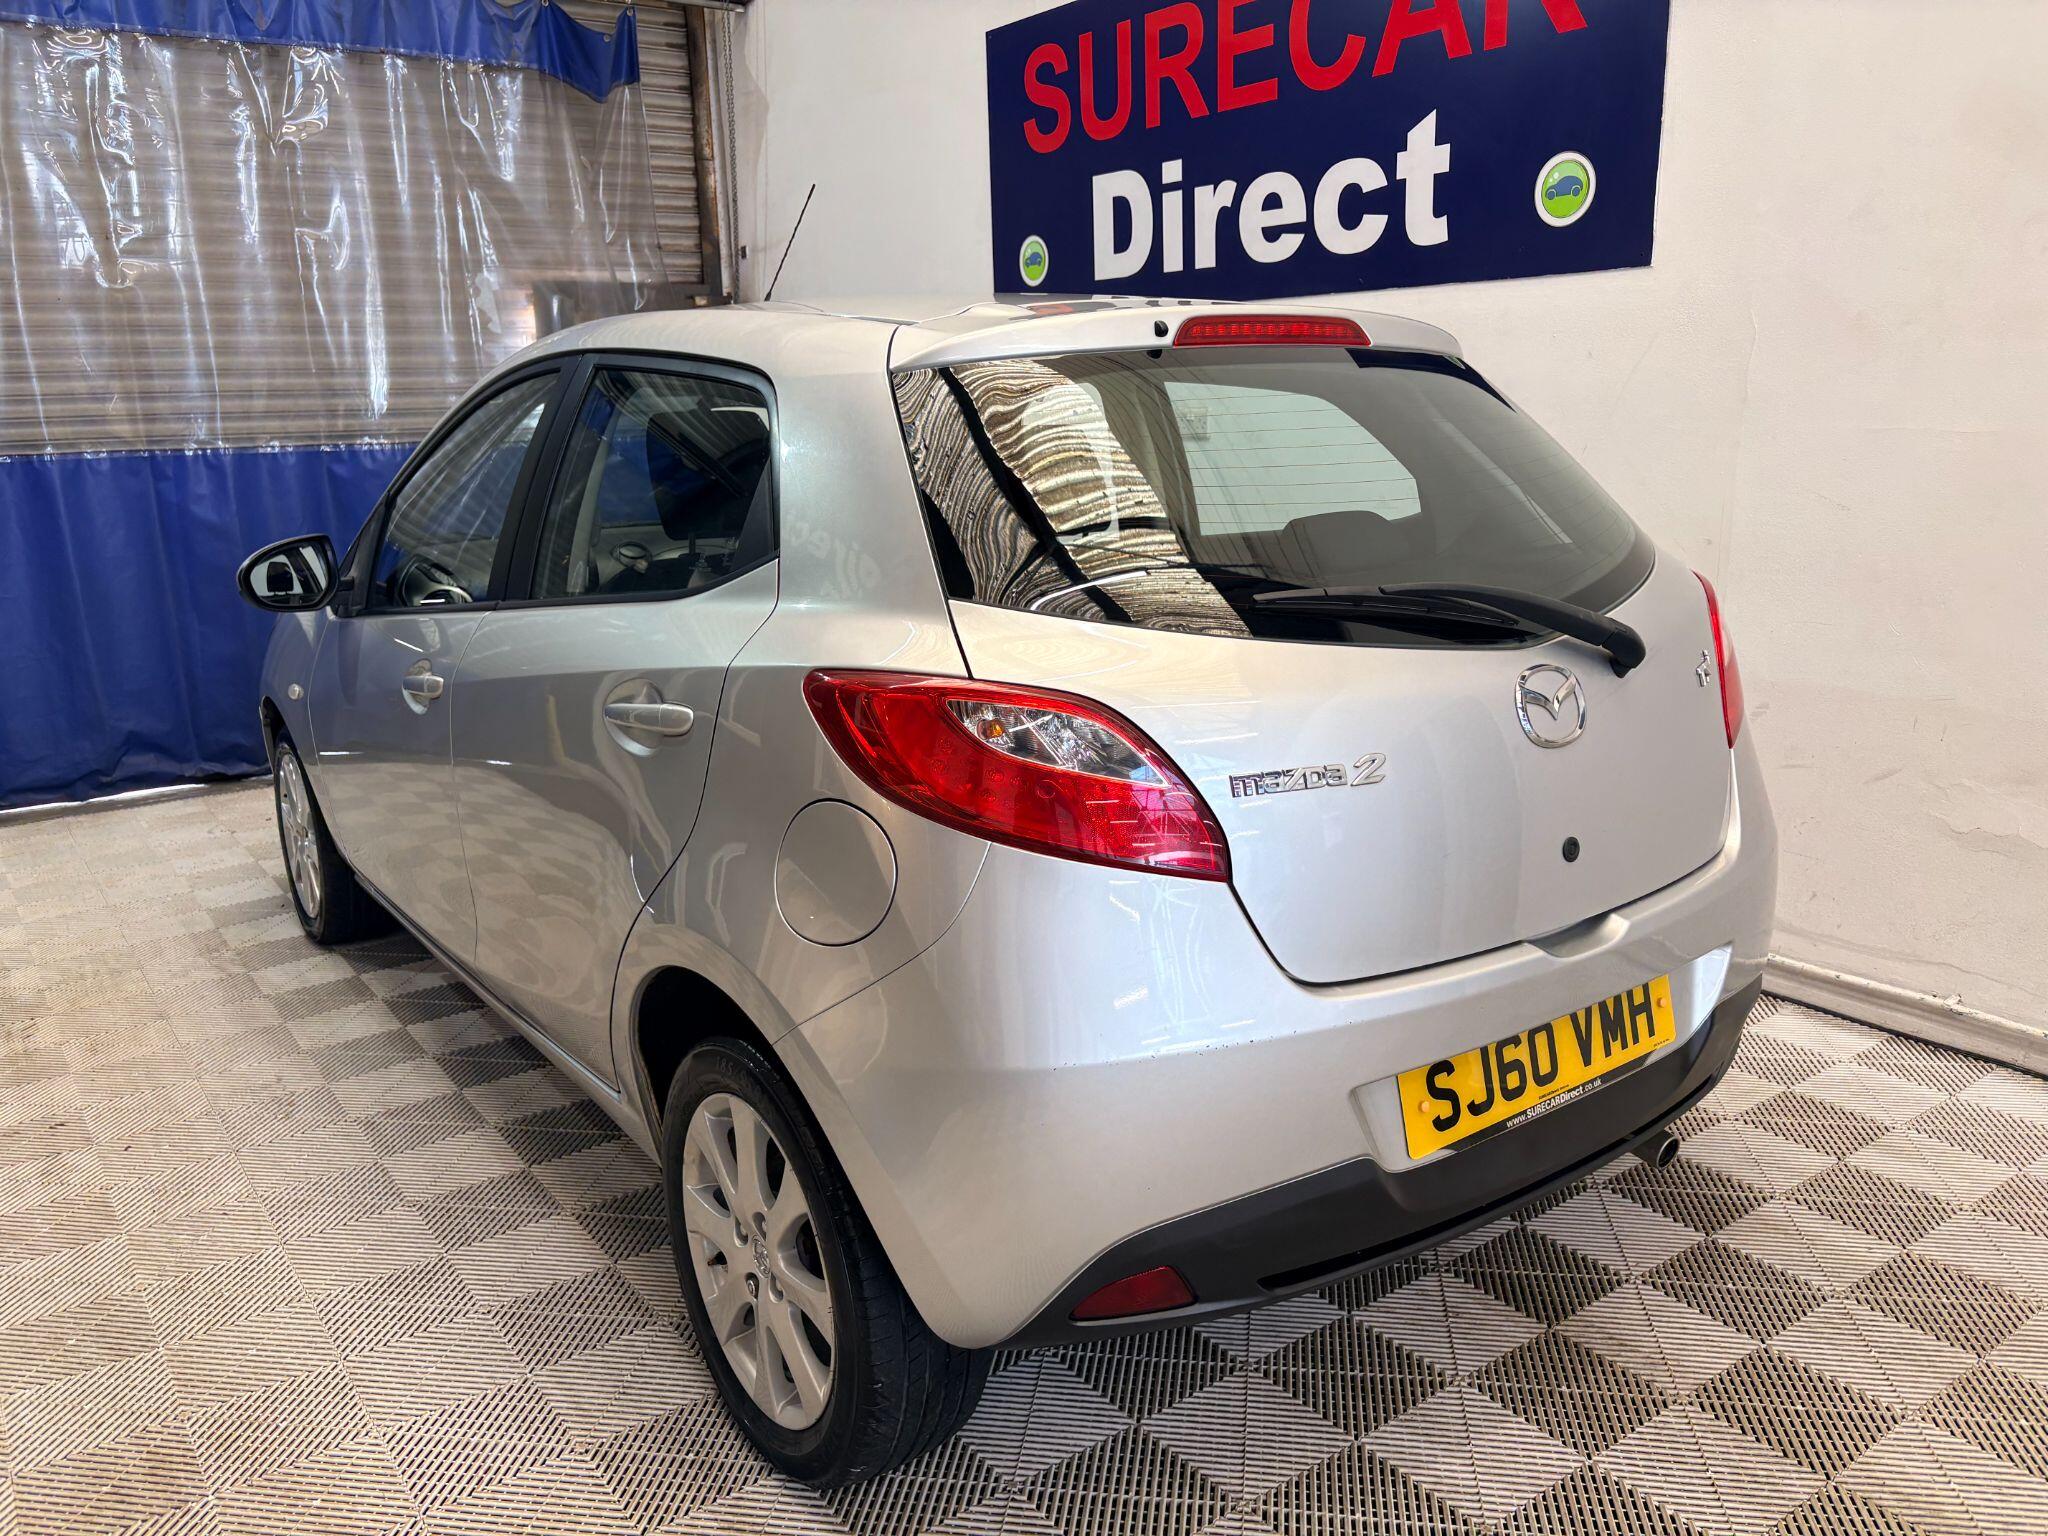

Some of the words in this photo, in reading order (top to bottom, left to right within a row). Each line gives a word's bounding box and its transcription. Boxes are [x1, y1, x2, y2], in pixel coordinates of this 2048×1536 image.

[1092, 109, 1450, 281] Direct
[1350, 752, 1387, 786] 2
[1425, 1022, 1559, 1132] SJ60
[1570, 982, 1656, 1068] VMH
[1506, 1078, 1602, 1128] www.SURECARDirect.co.uk
